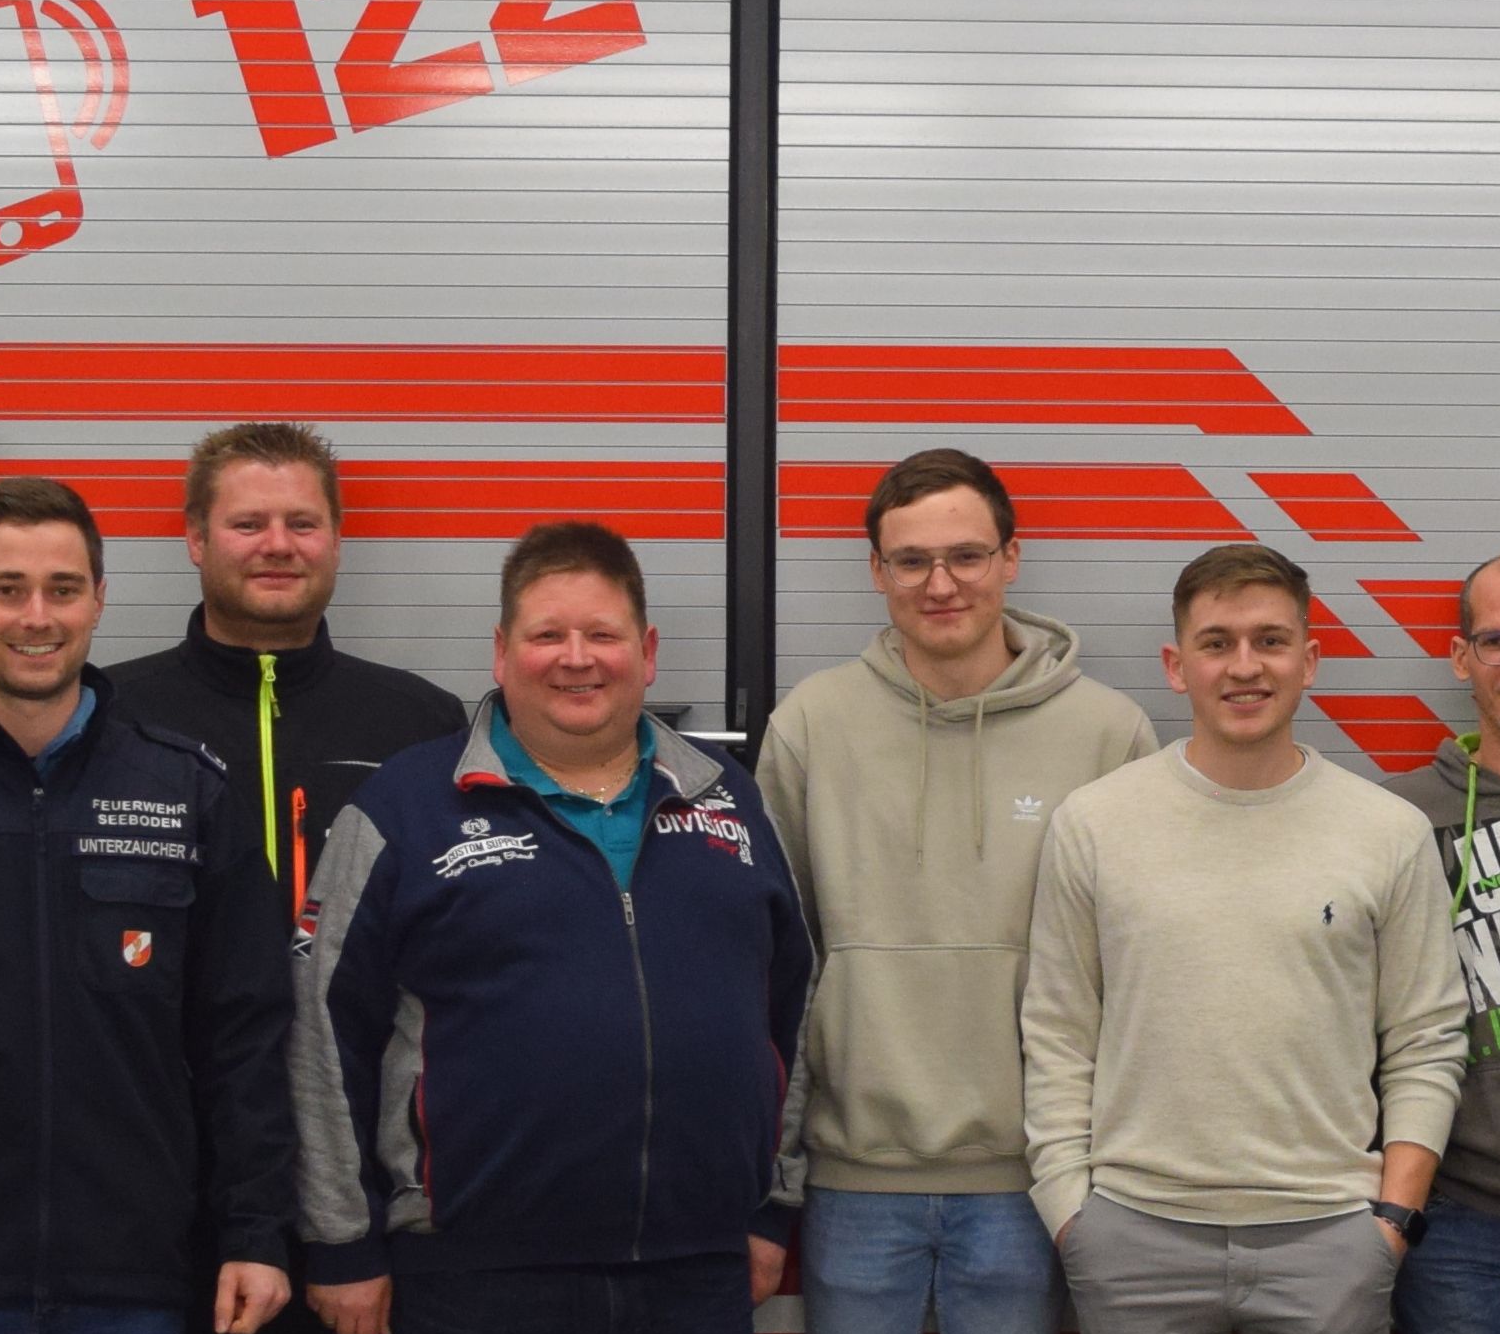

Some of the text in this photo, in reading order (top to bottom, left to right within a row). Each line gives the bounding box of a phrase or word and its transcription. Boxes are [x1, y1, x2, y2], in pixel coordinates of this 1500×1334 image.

[92, 798, 188, 815] FEUERWEHR
[97, 814, 182, 829] SEEBODEN
[79, 837, 186, 860] UNTERZAUCHER
[447, 836, 522, 862] CUSTOM SUPPLY
